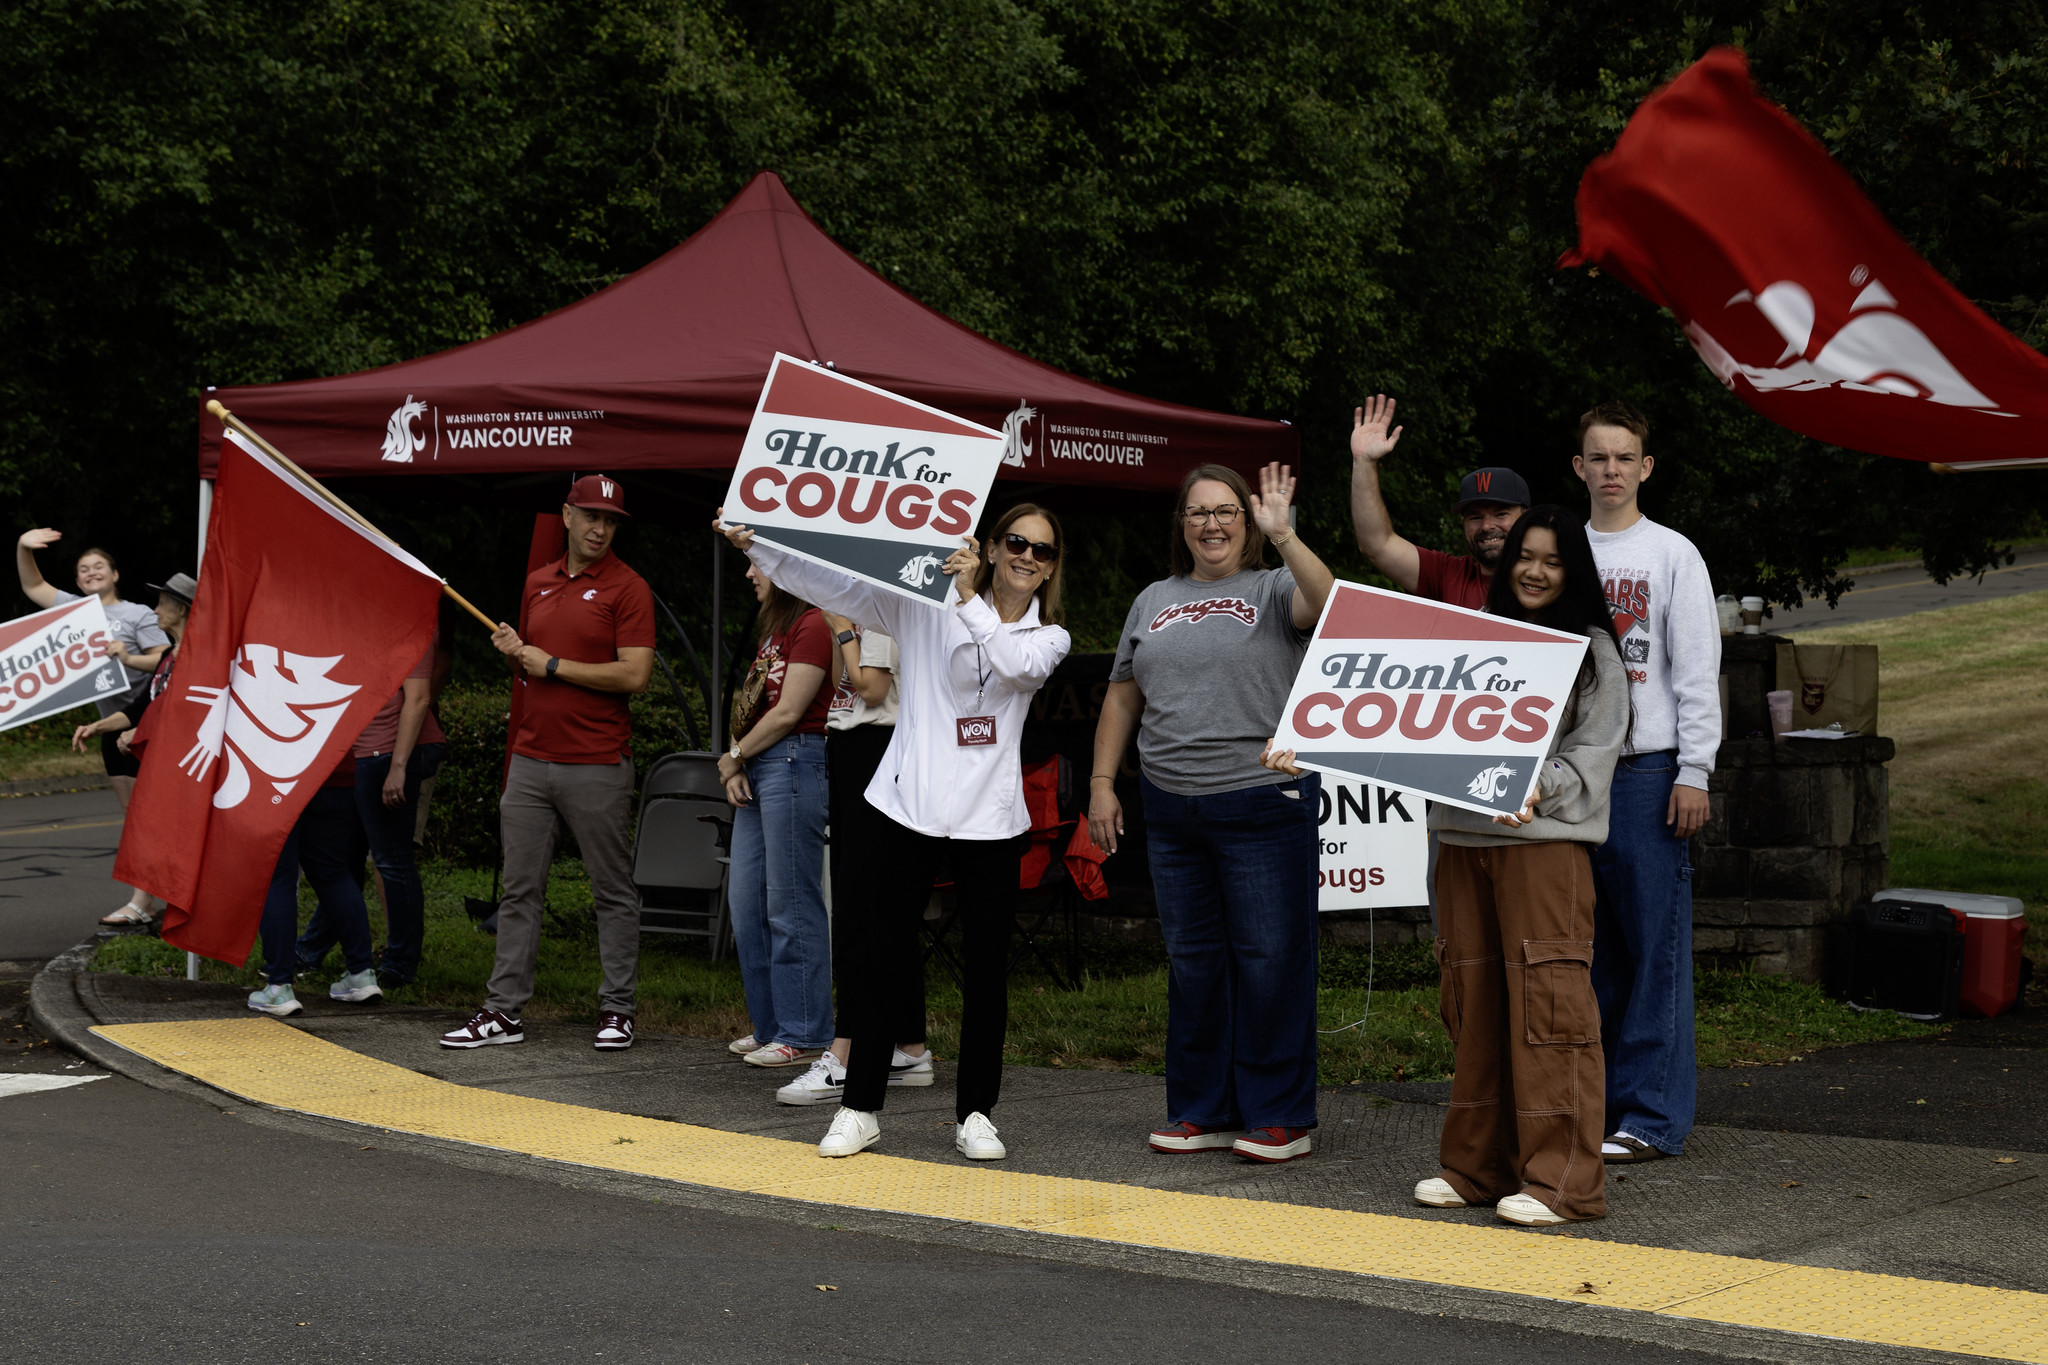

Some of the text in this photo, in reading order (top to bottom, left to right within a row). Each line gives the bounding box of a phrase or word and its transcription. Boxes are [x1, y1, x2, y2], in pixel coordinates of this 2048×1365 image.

[445, 410, 605, 424] WASHINGTON STATE UNIVERSITY
[446, 426, 573, 449] VANCOUVER
[1050, 424, 1169, 445] WASHINGTON STATE UNIVERSITY
[765, 428, 952, 484] Honk for
[1050, 439, 1144, 467] VANCOUVER
[601, 481, 614, 499] W
[1474, 471, 1493, 494] W
[739, 466, 977, 536] COUGS
[1149, 597, 1258, 633] Cougars
[68, 628, 87, 644] for
[0, 630, 110, 713] COUGS
[1321, 653, 1526, 692] Honk for
[1291, 691, 1555, 744] COUGS
[960, 721, 992, 740] WOW
